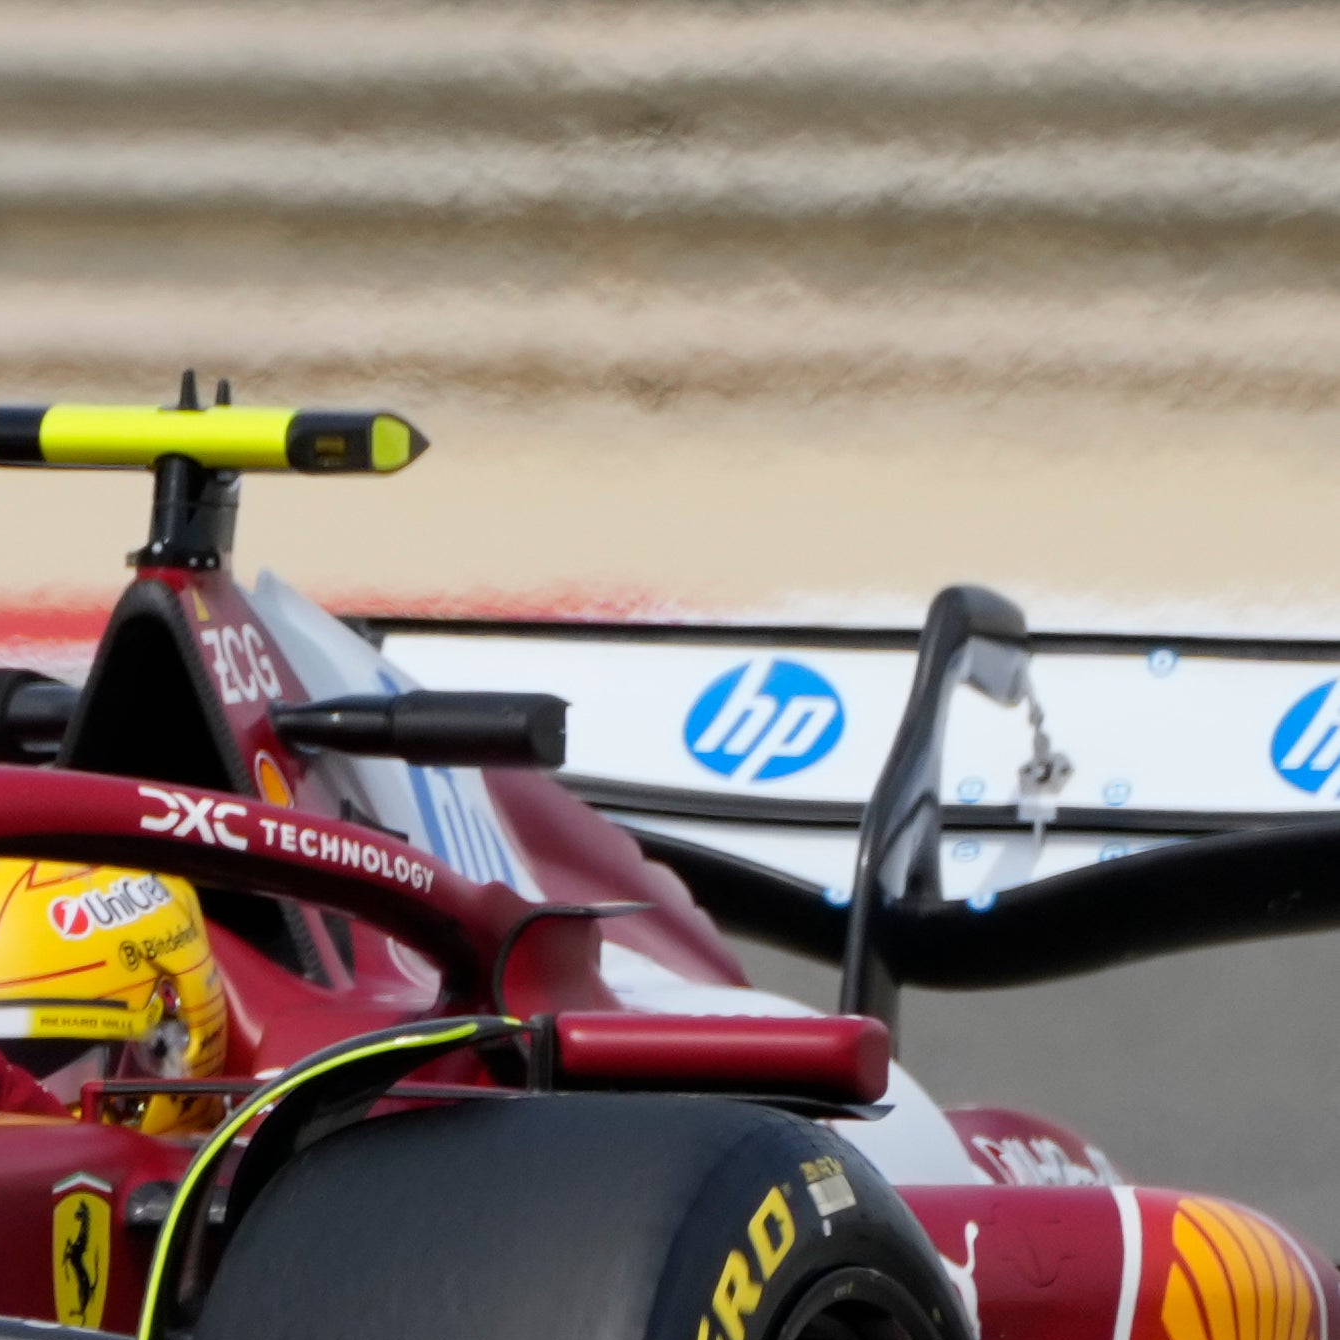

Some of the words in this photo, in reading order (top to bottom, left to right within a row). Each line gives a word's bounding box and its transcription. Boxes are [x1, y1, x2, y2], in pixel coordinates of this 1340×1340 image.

[200, 622, 283, 704] ZCG
[689, 659, 838, 782] hp
[137, 785, 249, 850] DXC
[257, 817, 435, 894] TECHNOLOGY
